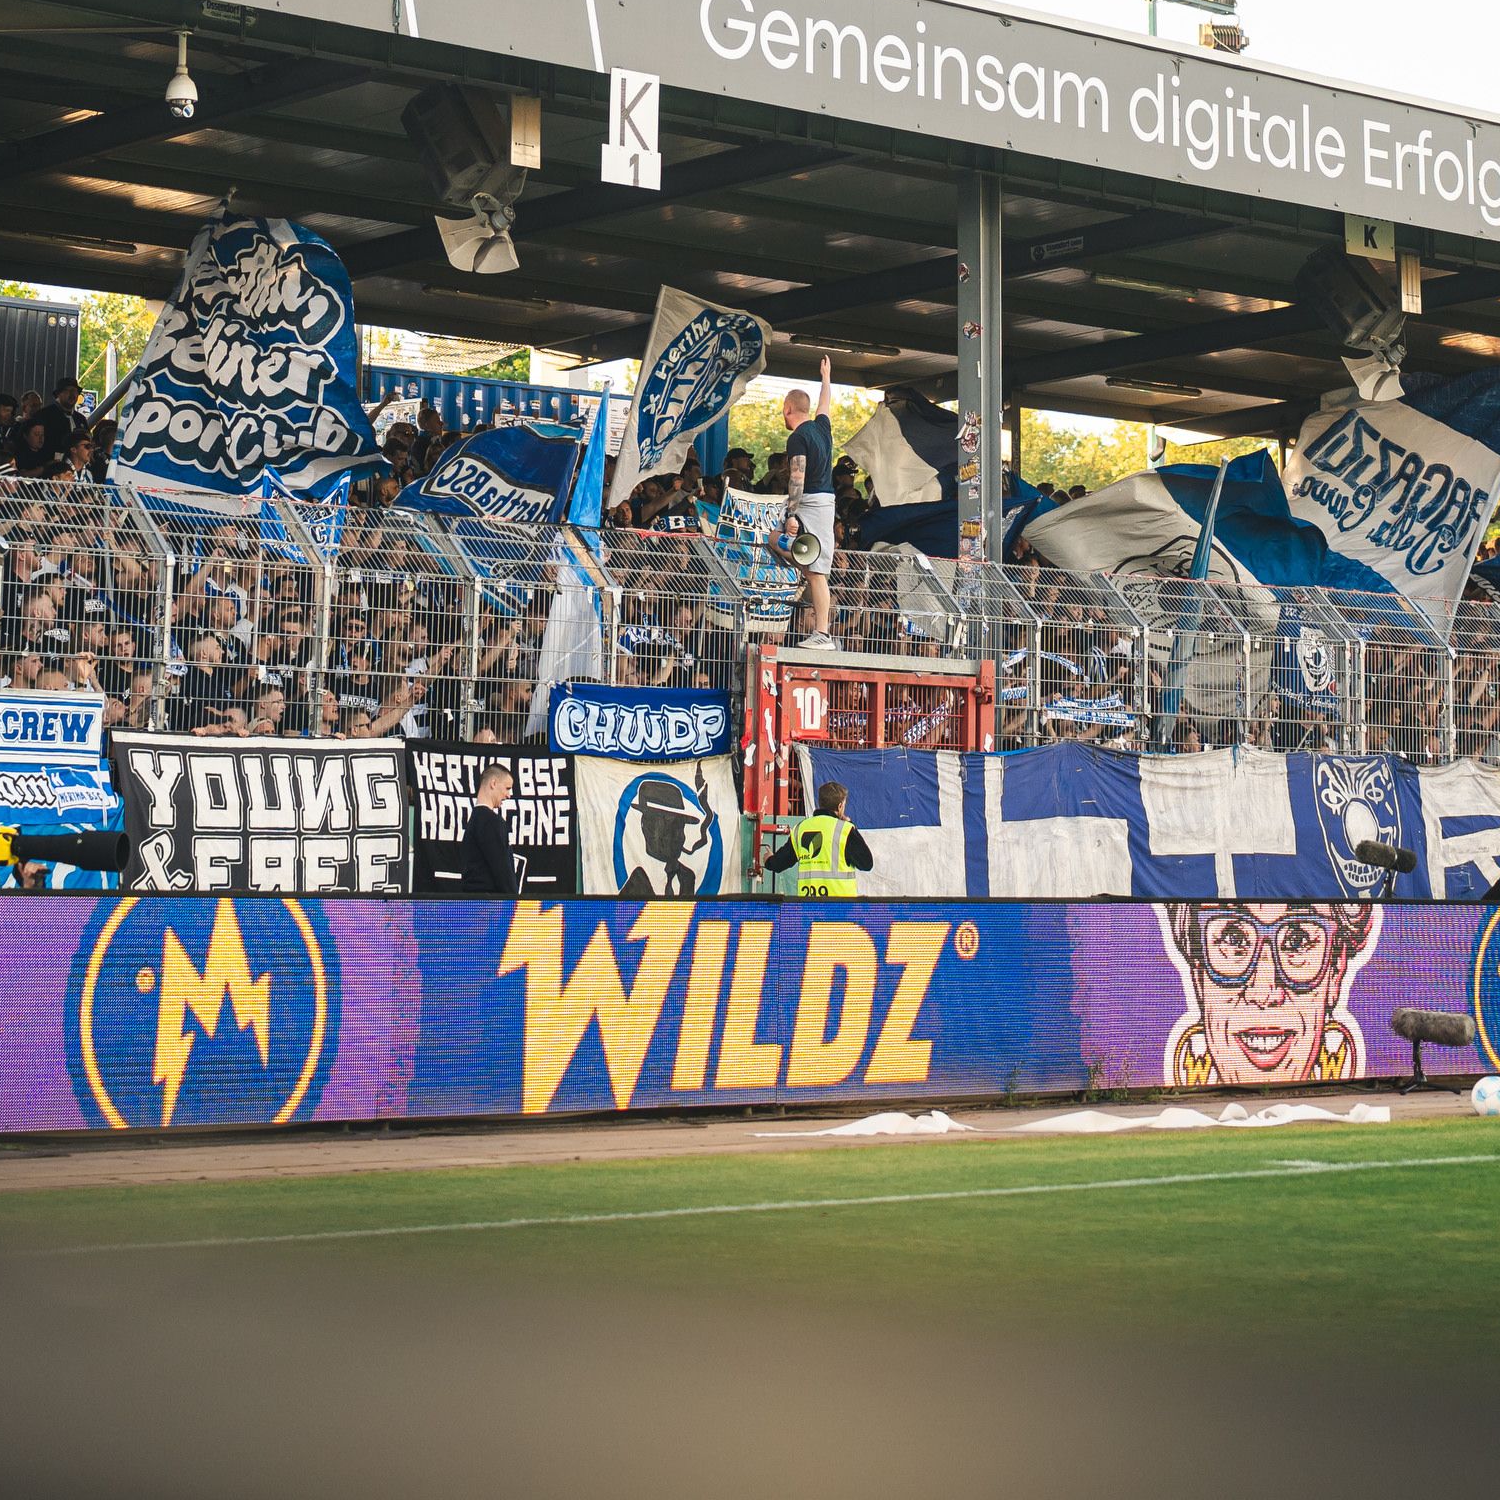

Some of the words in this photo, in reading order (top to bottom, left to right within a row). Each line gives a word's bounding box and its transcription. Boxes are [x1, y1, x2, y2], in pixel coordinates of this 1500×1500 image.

[619, 77, 651, 152] K
[1129, 70, 1346, 179] digitale
[1364, 224, 1378, 250] K
[1, 710, 95, 744] CREW
[792, 687, 822, 731] 10
[130, 749, 402, 832] YOUNG
[518, 758, 569, 796] BSC
